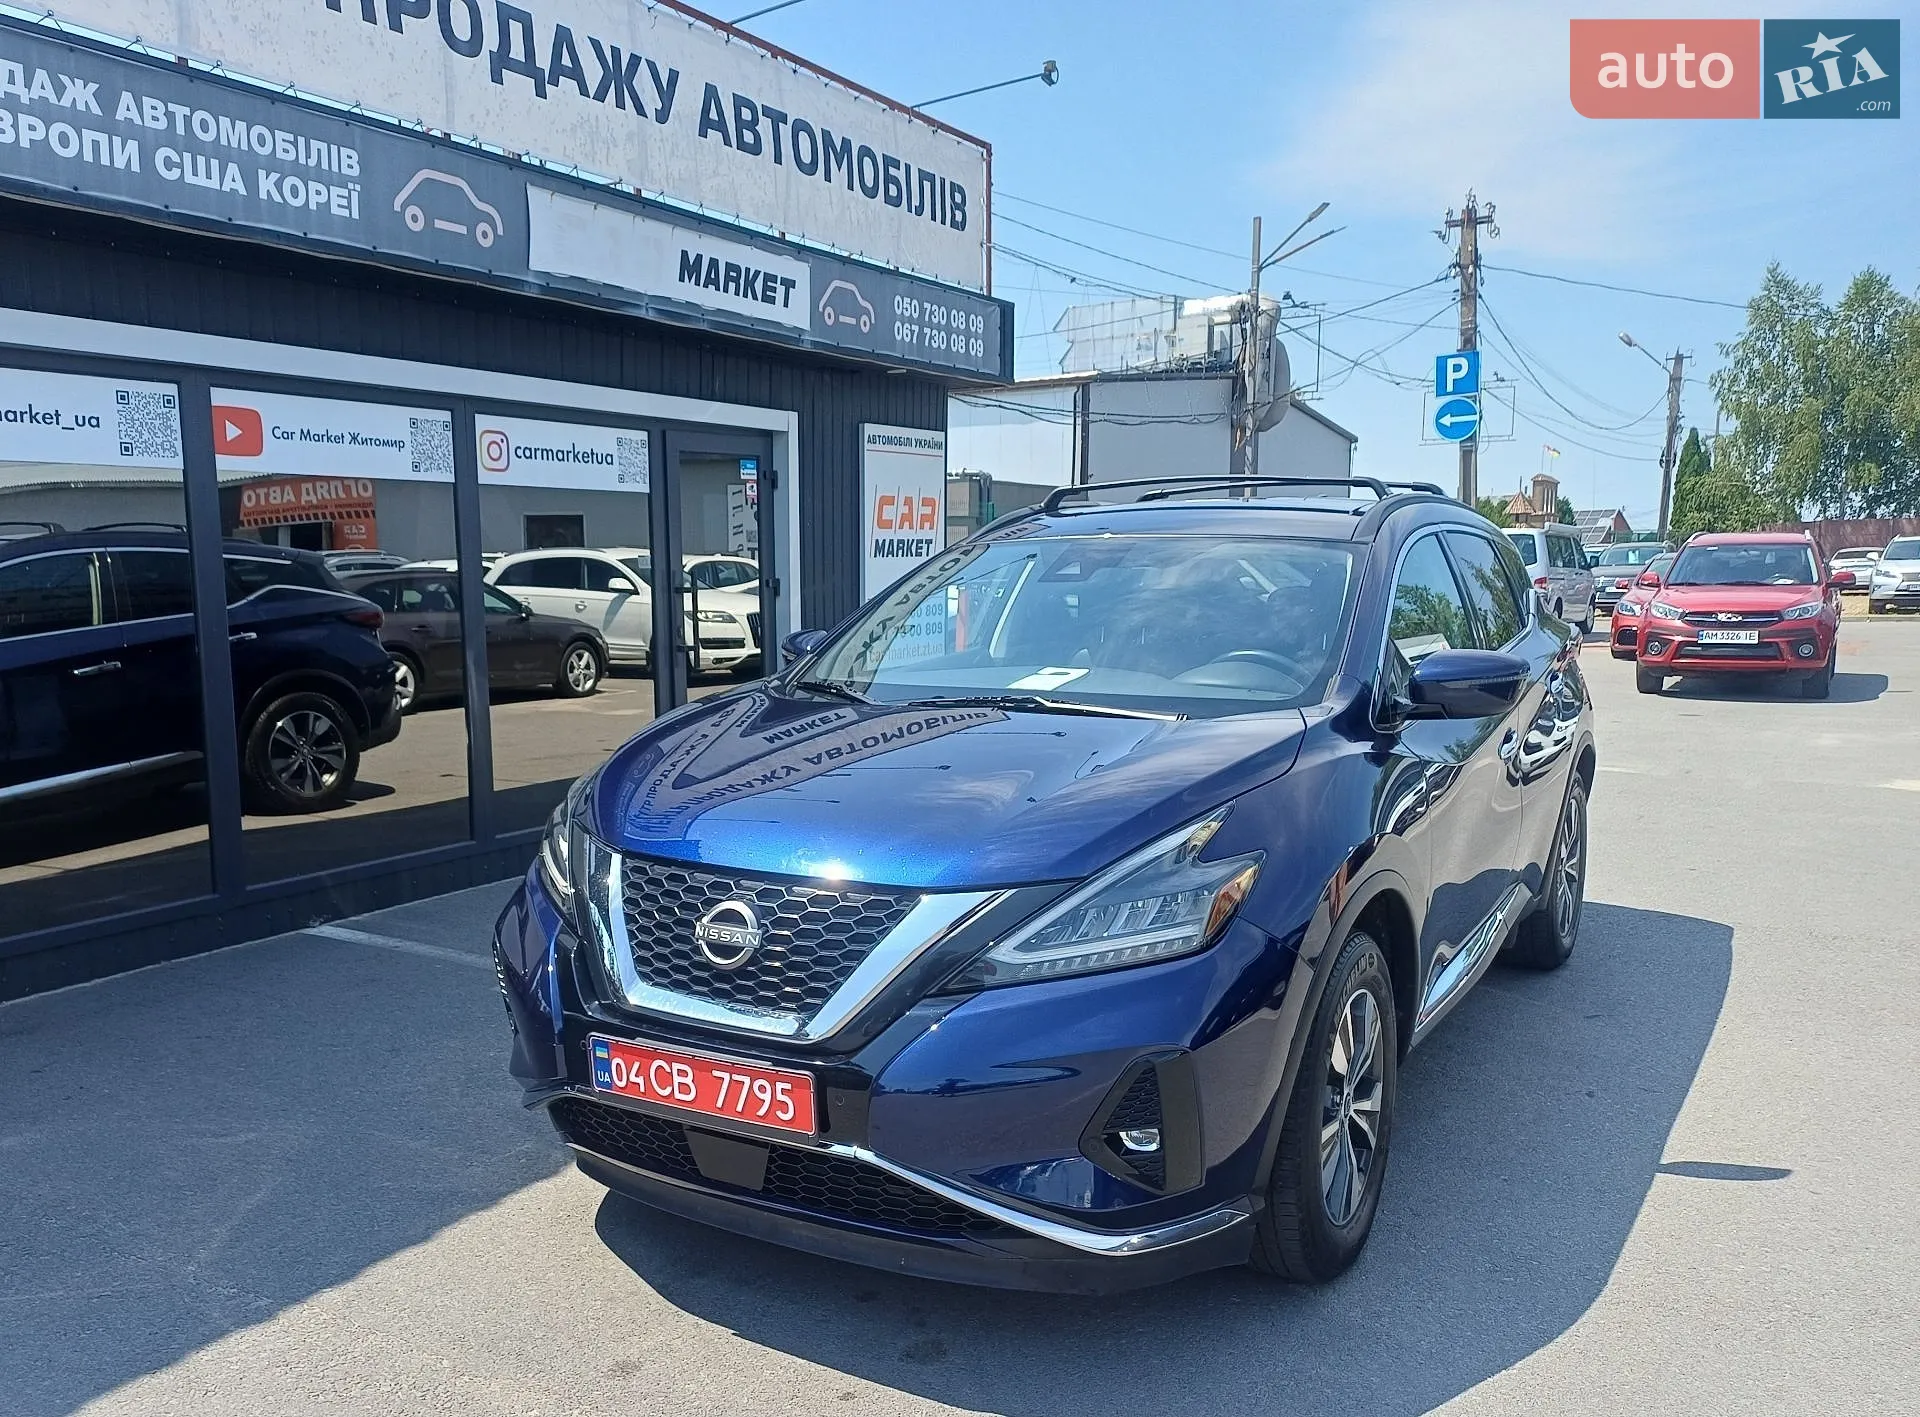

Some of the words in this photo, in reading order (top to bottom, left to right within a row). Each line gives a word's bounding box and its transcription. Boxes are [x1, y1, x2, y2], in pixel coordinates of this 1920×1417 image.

[115, 89, 361, 178] АВТОМОБІЛІВ
[325, 0, 679, 125] ОДАЖУ
[698, 83, 967, 232] АВТОМОБІЛІВ
[154, 146, 248, 194] США
[257, 171, 361, 221] КОРЕЇ
[678, 249, 796, 309] MARKET
[894, 294, 920, 319] 050
[923, 302, 947, 325] 730
[950, 308, 966, 330] 08
[969, 313, 984, 334] 09
[894, 320, 919, 344] 067
[923, 327, 947, 350] 730
[950, 333, 966, 354] 08
[969, 337, 984, 357] 09
[1446, 356, 1469, 393] P
[271, 425, 296, 441] Car
[299, 428, 345, 445] Market
[348, 431, 406, 453] Житомир
[514, 442, 614, 466] carmarketua
[866, 433, 913, 448] АВТОМОБІЛІ
[914, 437, 943, 450] УКРАЇНИ
[876, 495, 936, 530] CAR
[873, 538, 933, 558] MARKET
[925, 621, 943, 636] 809
[1704, 631, 1718, 640] AM
[695, 924, 761, 946] NISSAN
[597, 1069, 612, 1083] UA
[711, 1069, 796, 1122] 7795
